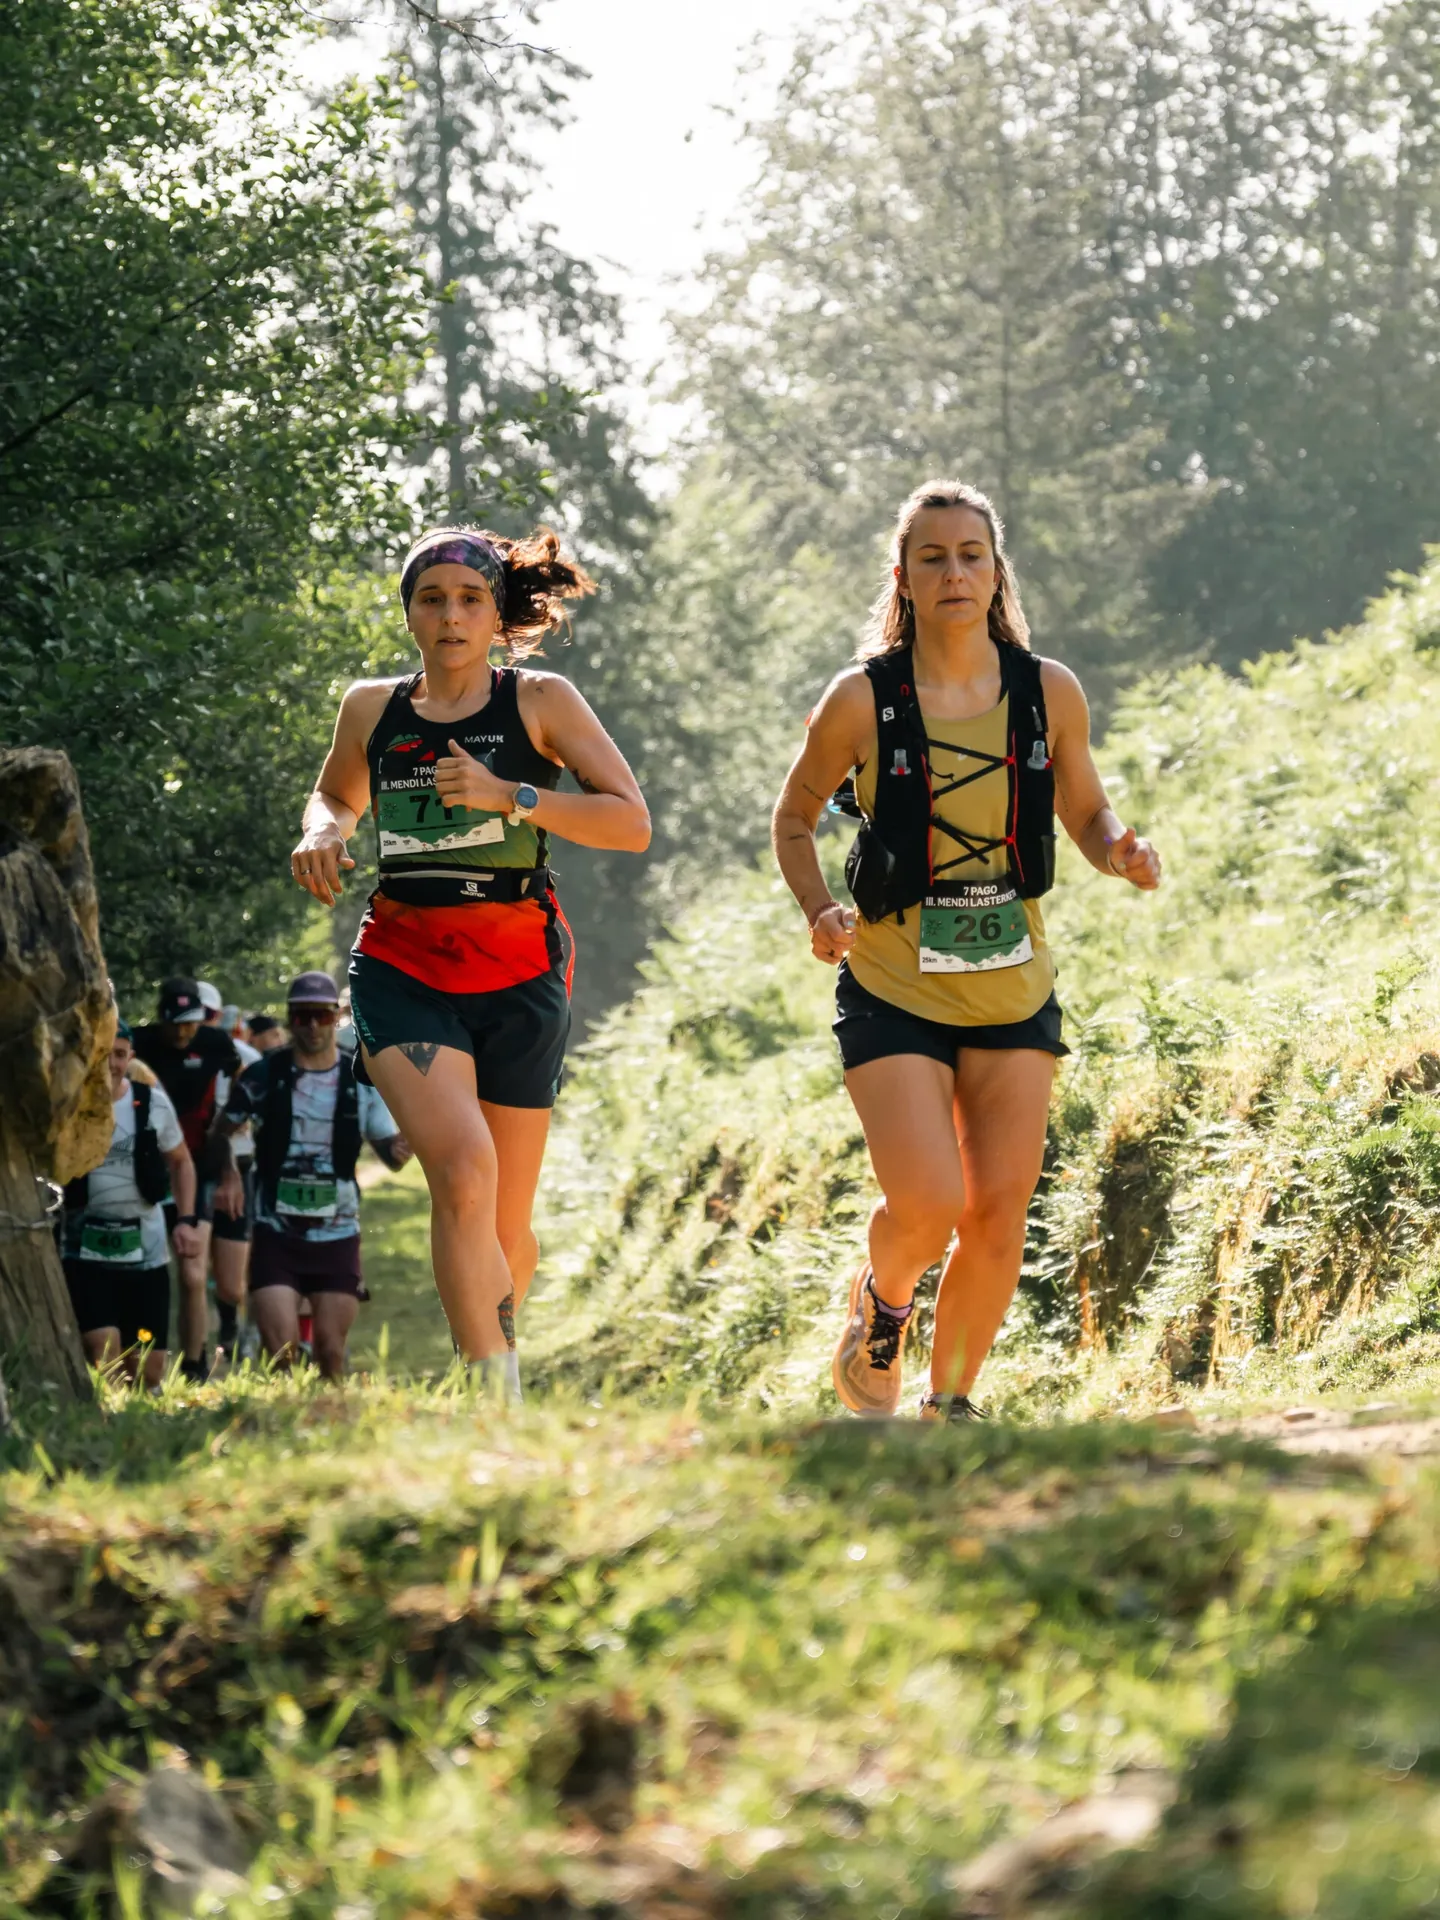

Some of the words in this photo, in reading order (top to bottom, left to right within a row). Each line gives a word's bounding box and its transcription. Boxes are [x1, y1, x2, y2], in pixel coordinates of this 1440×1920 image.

[413, 768, 419, 776] 7
[420, 766, 437, 775] PAG
[391, 779, 419, 789] MENDI
[408, 794, 453, 823] 71
[963, 886, 969, 896] 7
[970, 885, 998, 896] PAGO
[937, 897, 968, 907] MENDI
[954, 913, 1002, 943] 26
[295, 1186, 315, 1202] 11
